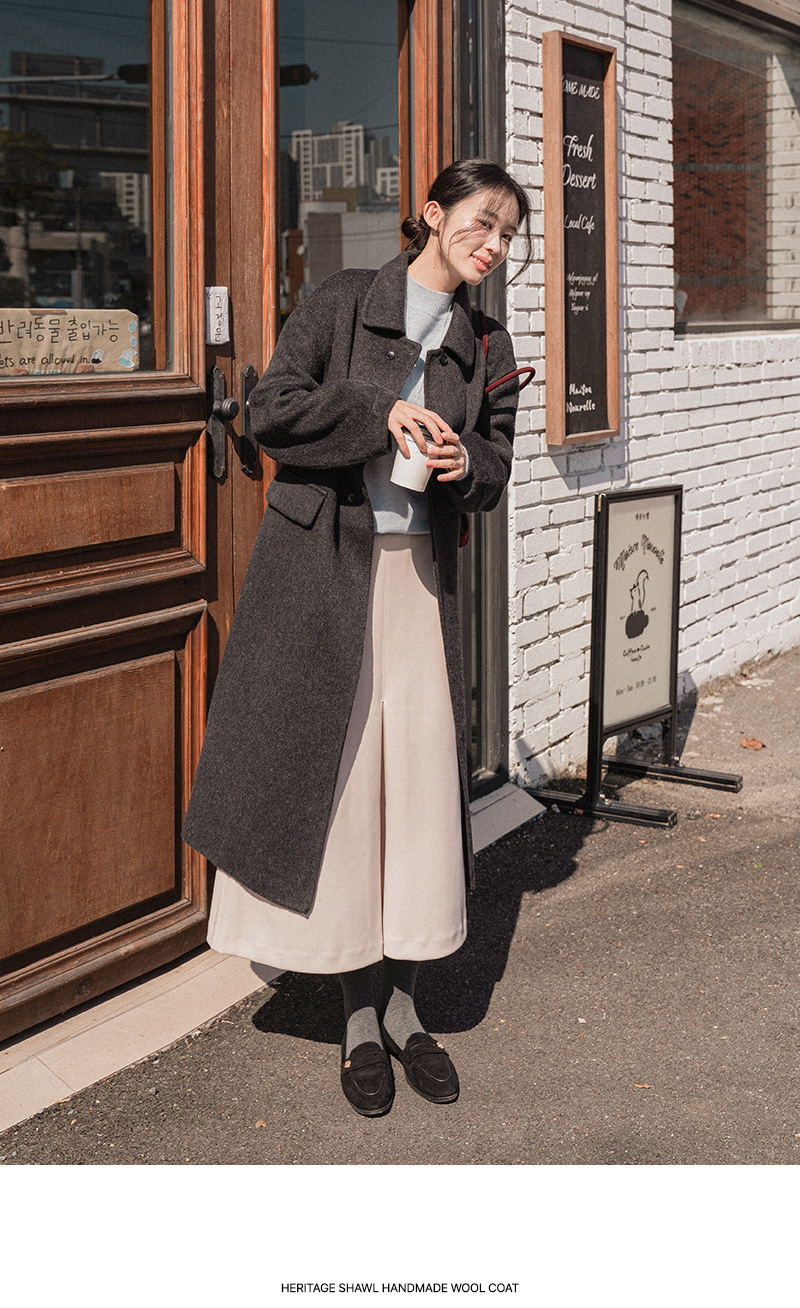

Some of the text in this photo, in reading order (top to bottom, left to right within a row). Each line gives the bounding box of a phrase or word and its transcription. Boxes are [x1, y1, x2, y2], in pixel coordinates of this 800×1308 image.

[563, 134, 594, 162] Fresh
[563, 164, 597, 189] Dessert
[67, 316, 120, 342] 출입가능
[19, 356, 36, 366] are
